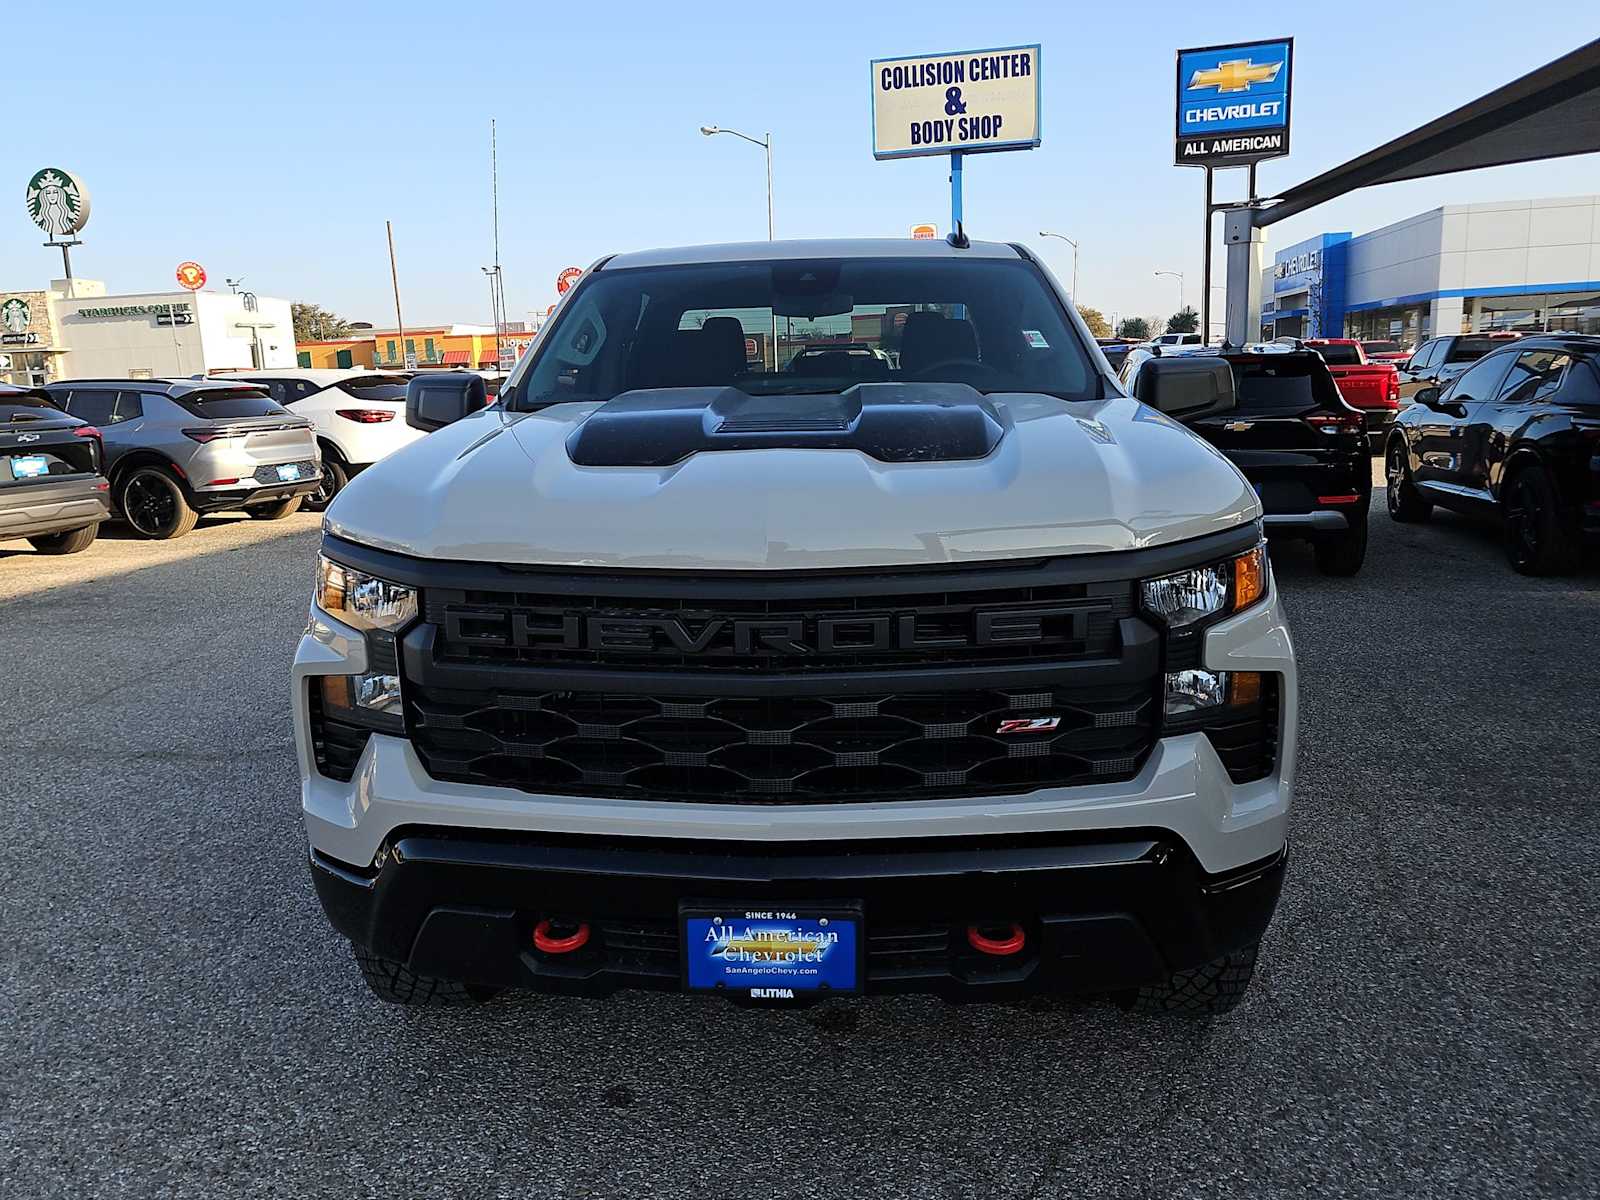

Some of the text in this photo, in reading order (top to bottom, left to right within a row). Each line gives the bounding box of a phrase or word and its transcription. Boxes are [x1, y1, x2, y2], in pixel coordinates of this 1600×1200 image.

[881, 53, 1031, 91] COLLISION CENTER
[944, 86, 967, 116] &
[1185, 101, 1282, 123] CHEVROLET
[911, 115, 1003, 145] BODY SHOP
[1184, 135, 1281, 156] ALL AMERICAN
[1285, 250, 1318, 276] CHEVROLET
[78, 305, 146, 319] STARBUCKS
[445, 598, 1112, 656] CHEVROLET
[995, 717, 1062, 734] Z71
[745, 911, 797, 920] SINCE 1946
[704, 926, 839, 943] All American
[723, 946, 824, 963] Chevrolet
[725, 966, 818, 976] SanAngeloChevy.com
[760, 988, 794, 999] LITHIA
